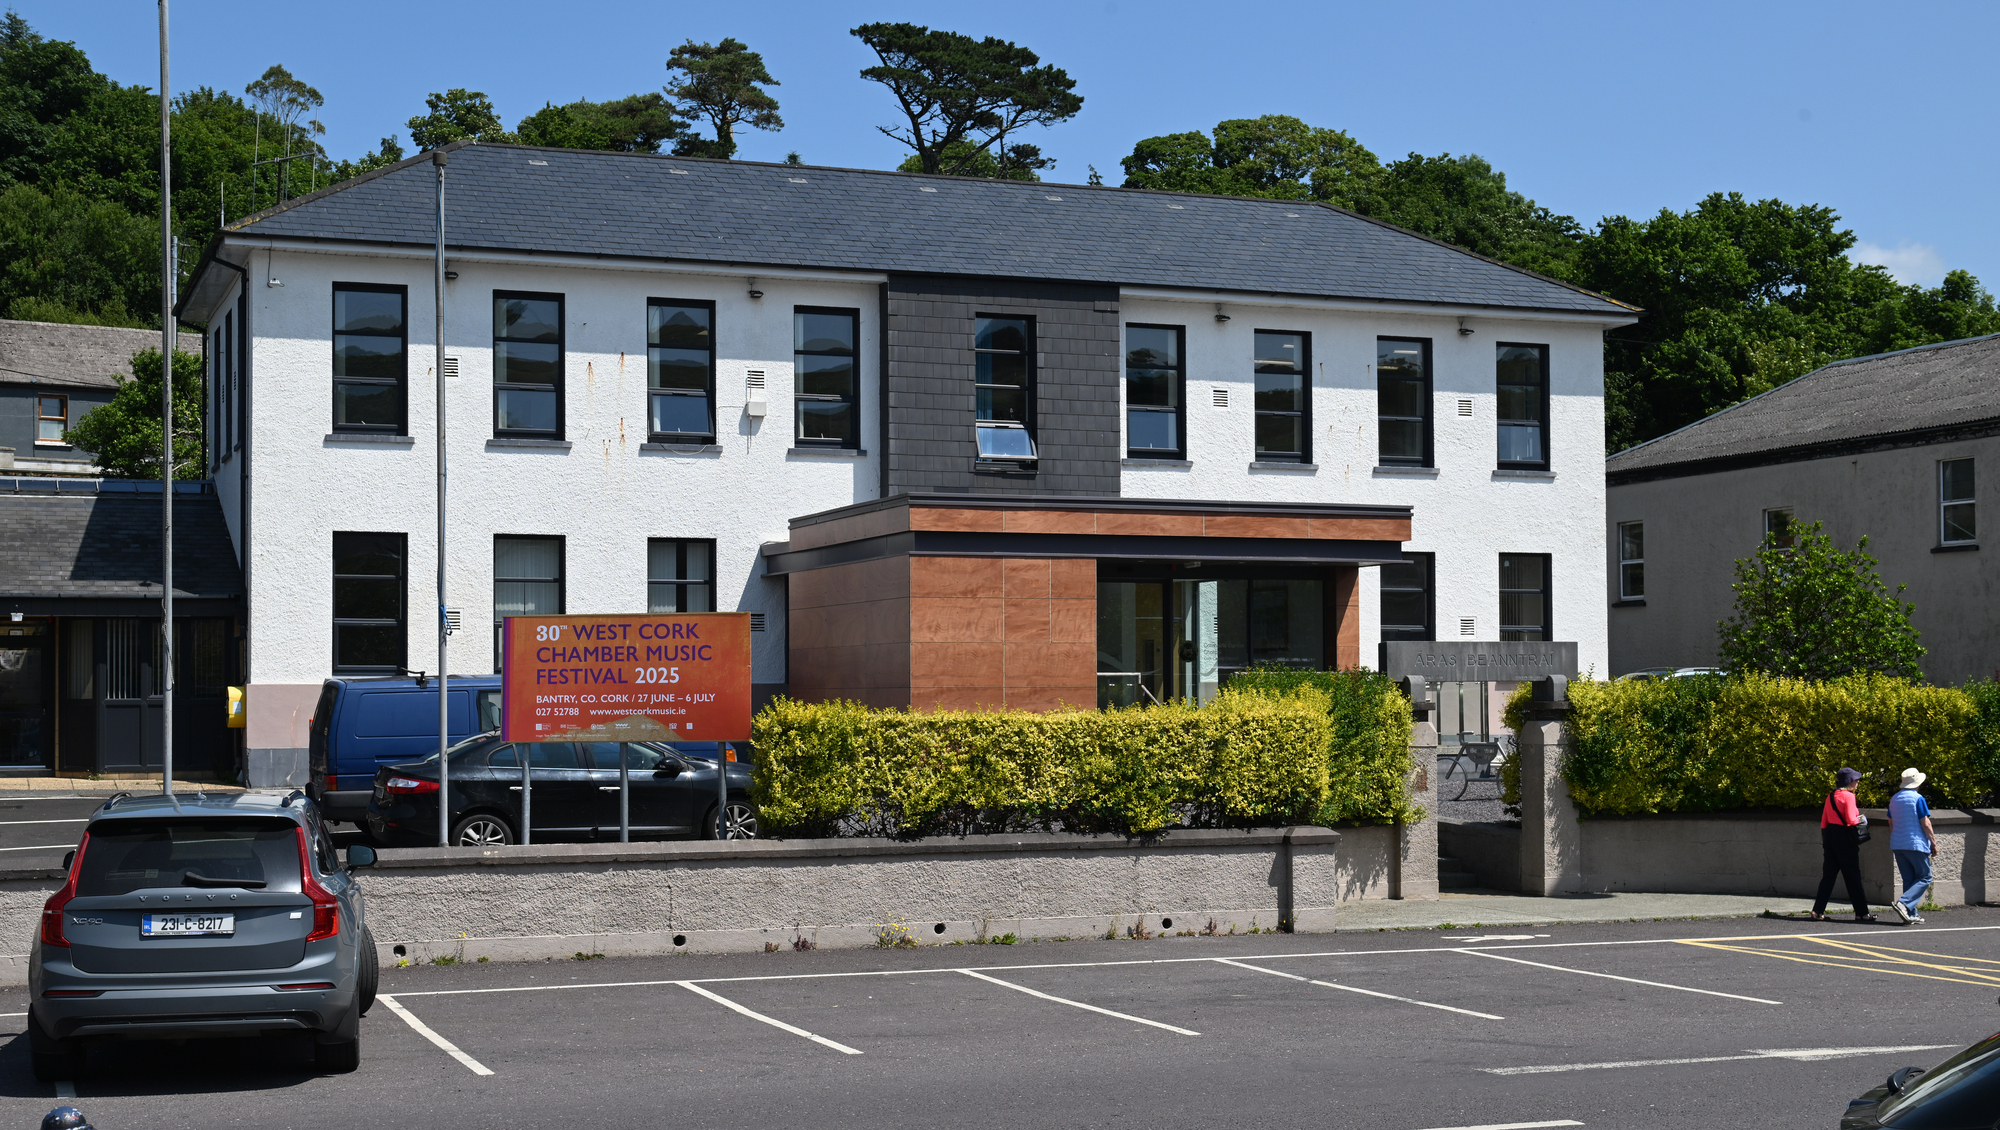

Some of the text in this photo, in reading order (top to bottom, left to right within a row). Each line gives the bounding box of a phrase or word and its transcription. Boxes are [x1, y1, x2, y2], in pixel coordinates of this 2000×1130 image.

[572, 624, 632, 640] WEST
[638, 623, 700, 640] CORK
[536, 644, 712, 663] CHAMBER MUSIC
[1414, 650, 1554, 668] ÁRAS BEANNTRAÍ
[536, 666, 680, 685] FESTIVAL 2025
[536, 694, 578, 704] BANTRY,
[580, 694, 598, 703] CO.
[600, 694, 629, 703] CORK
[637, 693, 649, 703] 27
[650, 693, 675, 705] JUNE
[685, 693, 692, 702] 6
[693, 693, 716, 704] JULY
[536, 706, 687, 716] 027 52788 www.westcorkmusic.ie
[139, 893, 238, 903] VOLVO
[72, 917, 104, 925] XC90
[160, 917, 224, 931] 231-C-8217
